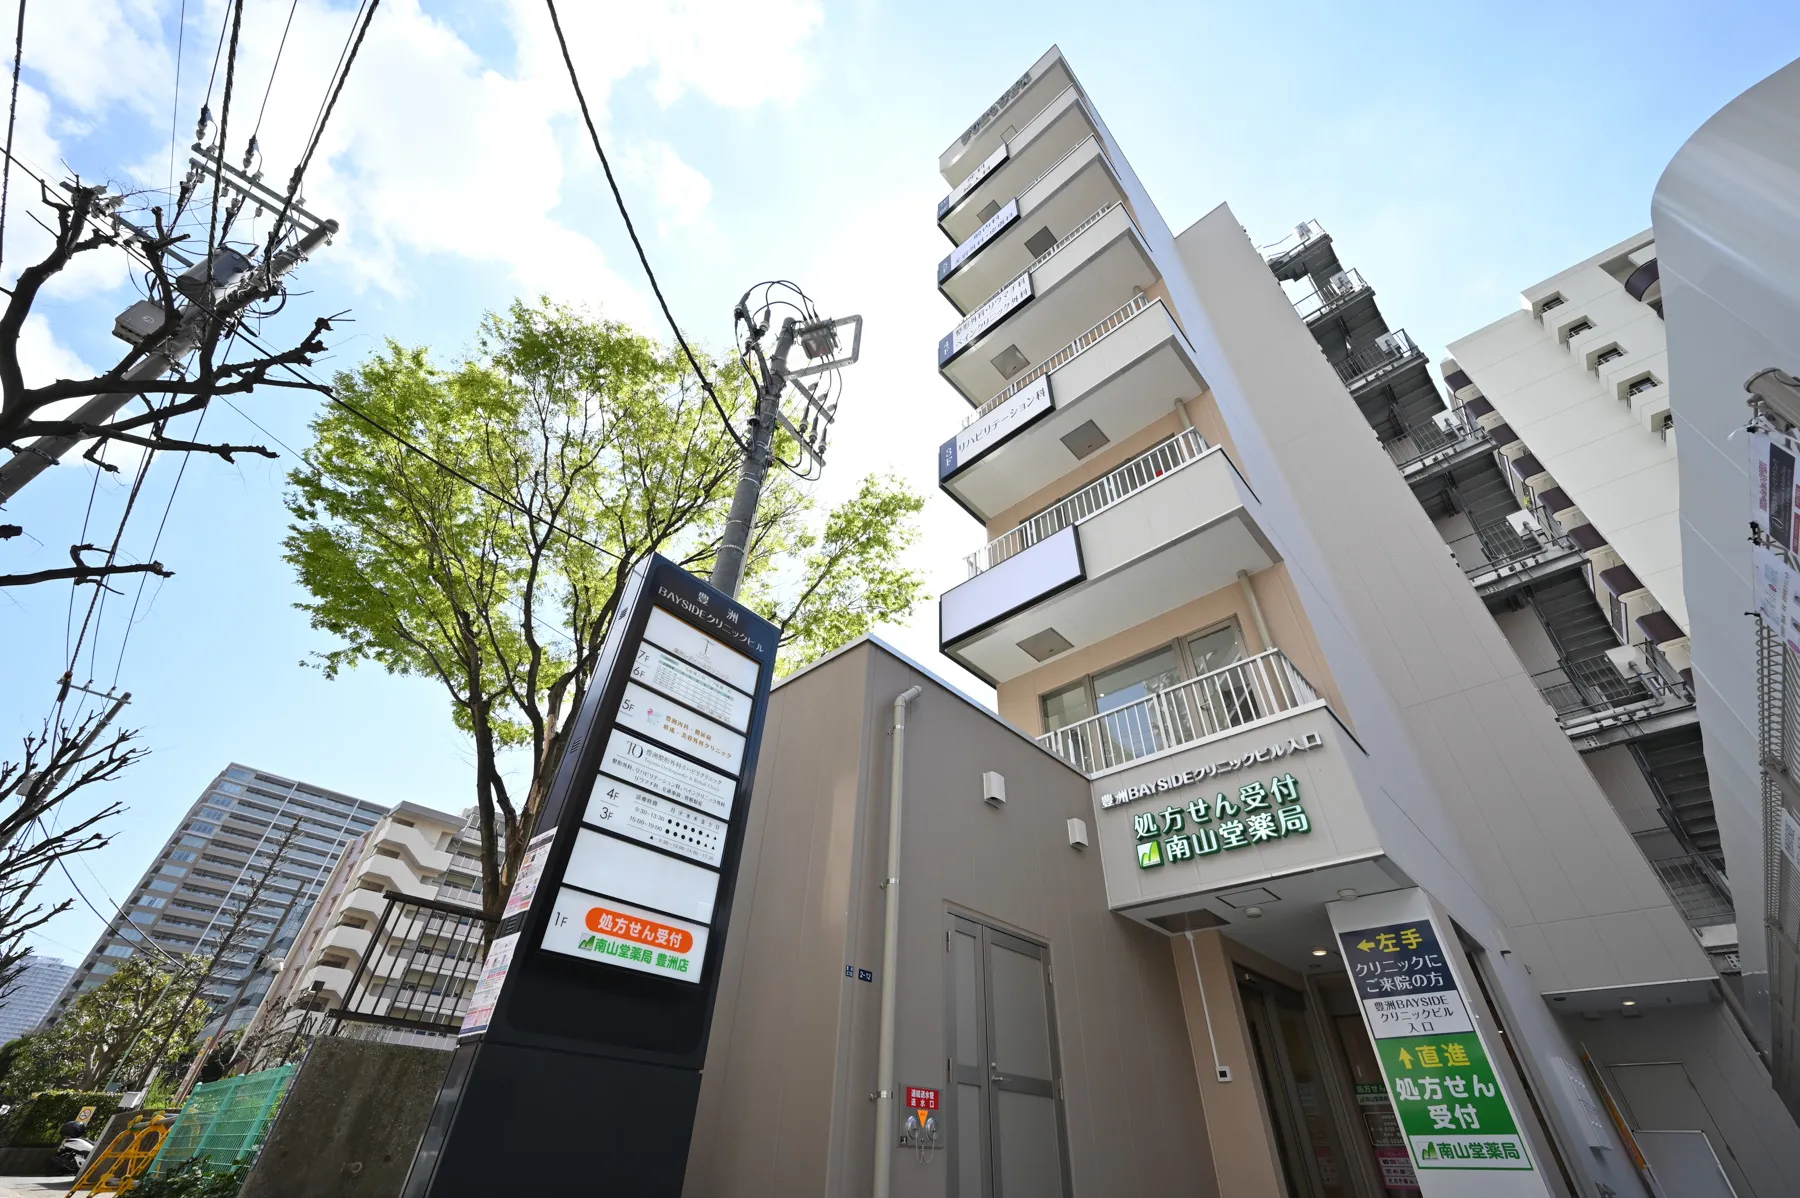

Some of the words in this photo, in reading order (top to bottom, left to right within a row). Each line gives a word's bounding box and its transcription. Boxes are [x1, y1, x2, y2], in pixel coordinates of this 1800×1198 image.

[958, 388, 1045, 452] リハビリテーション科
[658, 586, 764, 653] BAYSIDEクリニックビル
[638, 650, 650, 662] 7F
[633, 666, 645, 677] 6F
[622, 699, 635, 711] 5F
[1101, 730, 1323, 809] 豊洲BAYSIDEクリニックビル入口
[606, 788, 620, 800] 4F
[599, 807, 613, 820] 3F
[1134, 773, 1299, 842] 処方せん受付
[1165, 804, 1312, 863] 南山堂薬局
[555, 912, 568, 927] 1F
[598, 913, 683, 948] 処方せん受付
[1379, 928, 1423, 952] 左手
[594, 937, 652, 964] 南山堂薬局
[655, 953, 689, 972] 豊洲店
[1355, 954, 1442, 977] クリニックに
[1366, 971, 1444, 993] ご来院の方
[1374, 995, 1449, 1012] 豊洲BAYSIDE
[1380, 1007, 1453, 1023] クリニックビル
[1408, 1021, 1435, 1034] 入口
[1415, 1042, 1471, 1068] 直進
[1395, 1074, 1495, 1101] 処方せん
[1427, 1103, 1480, 1130] 受付
[1437, 1141, 1520, 1160] 南山堂薬局
